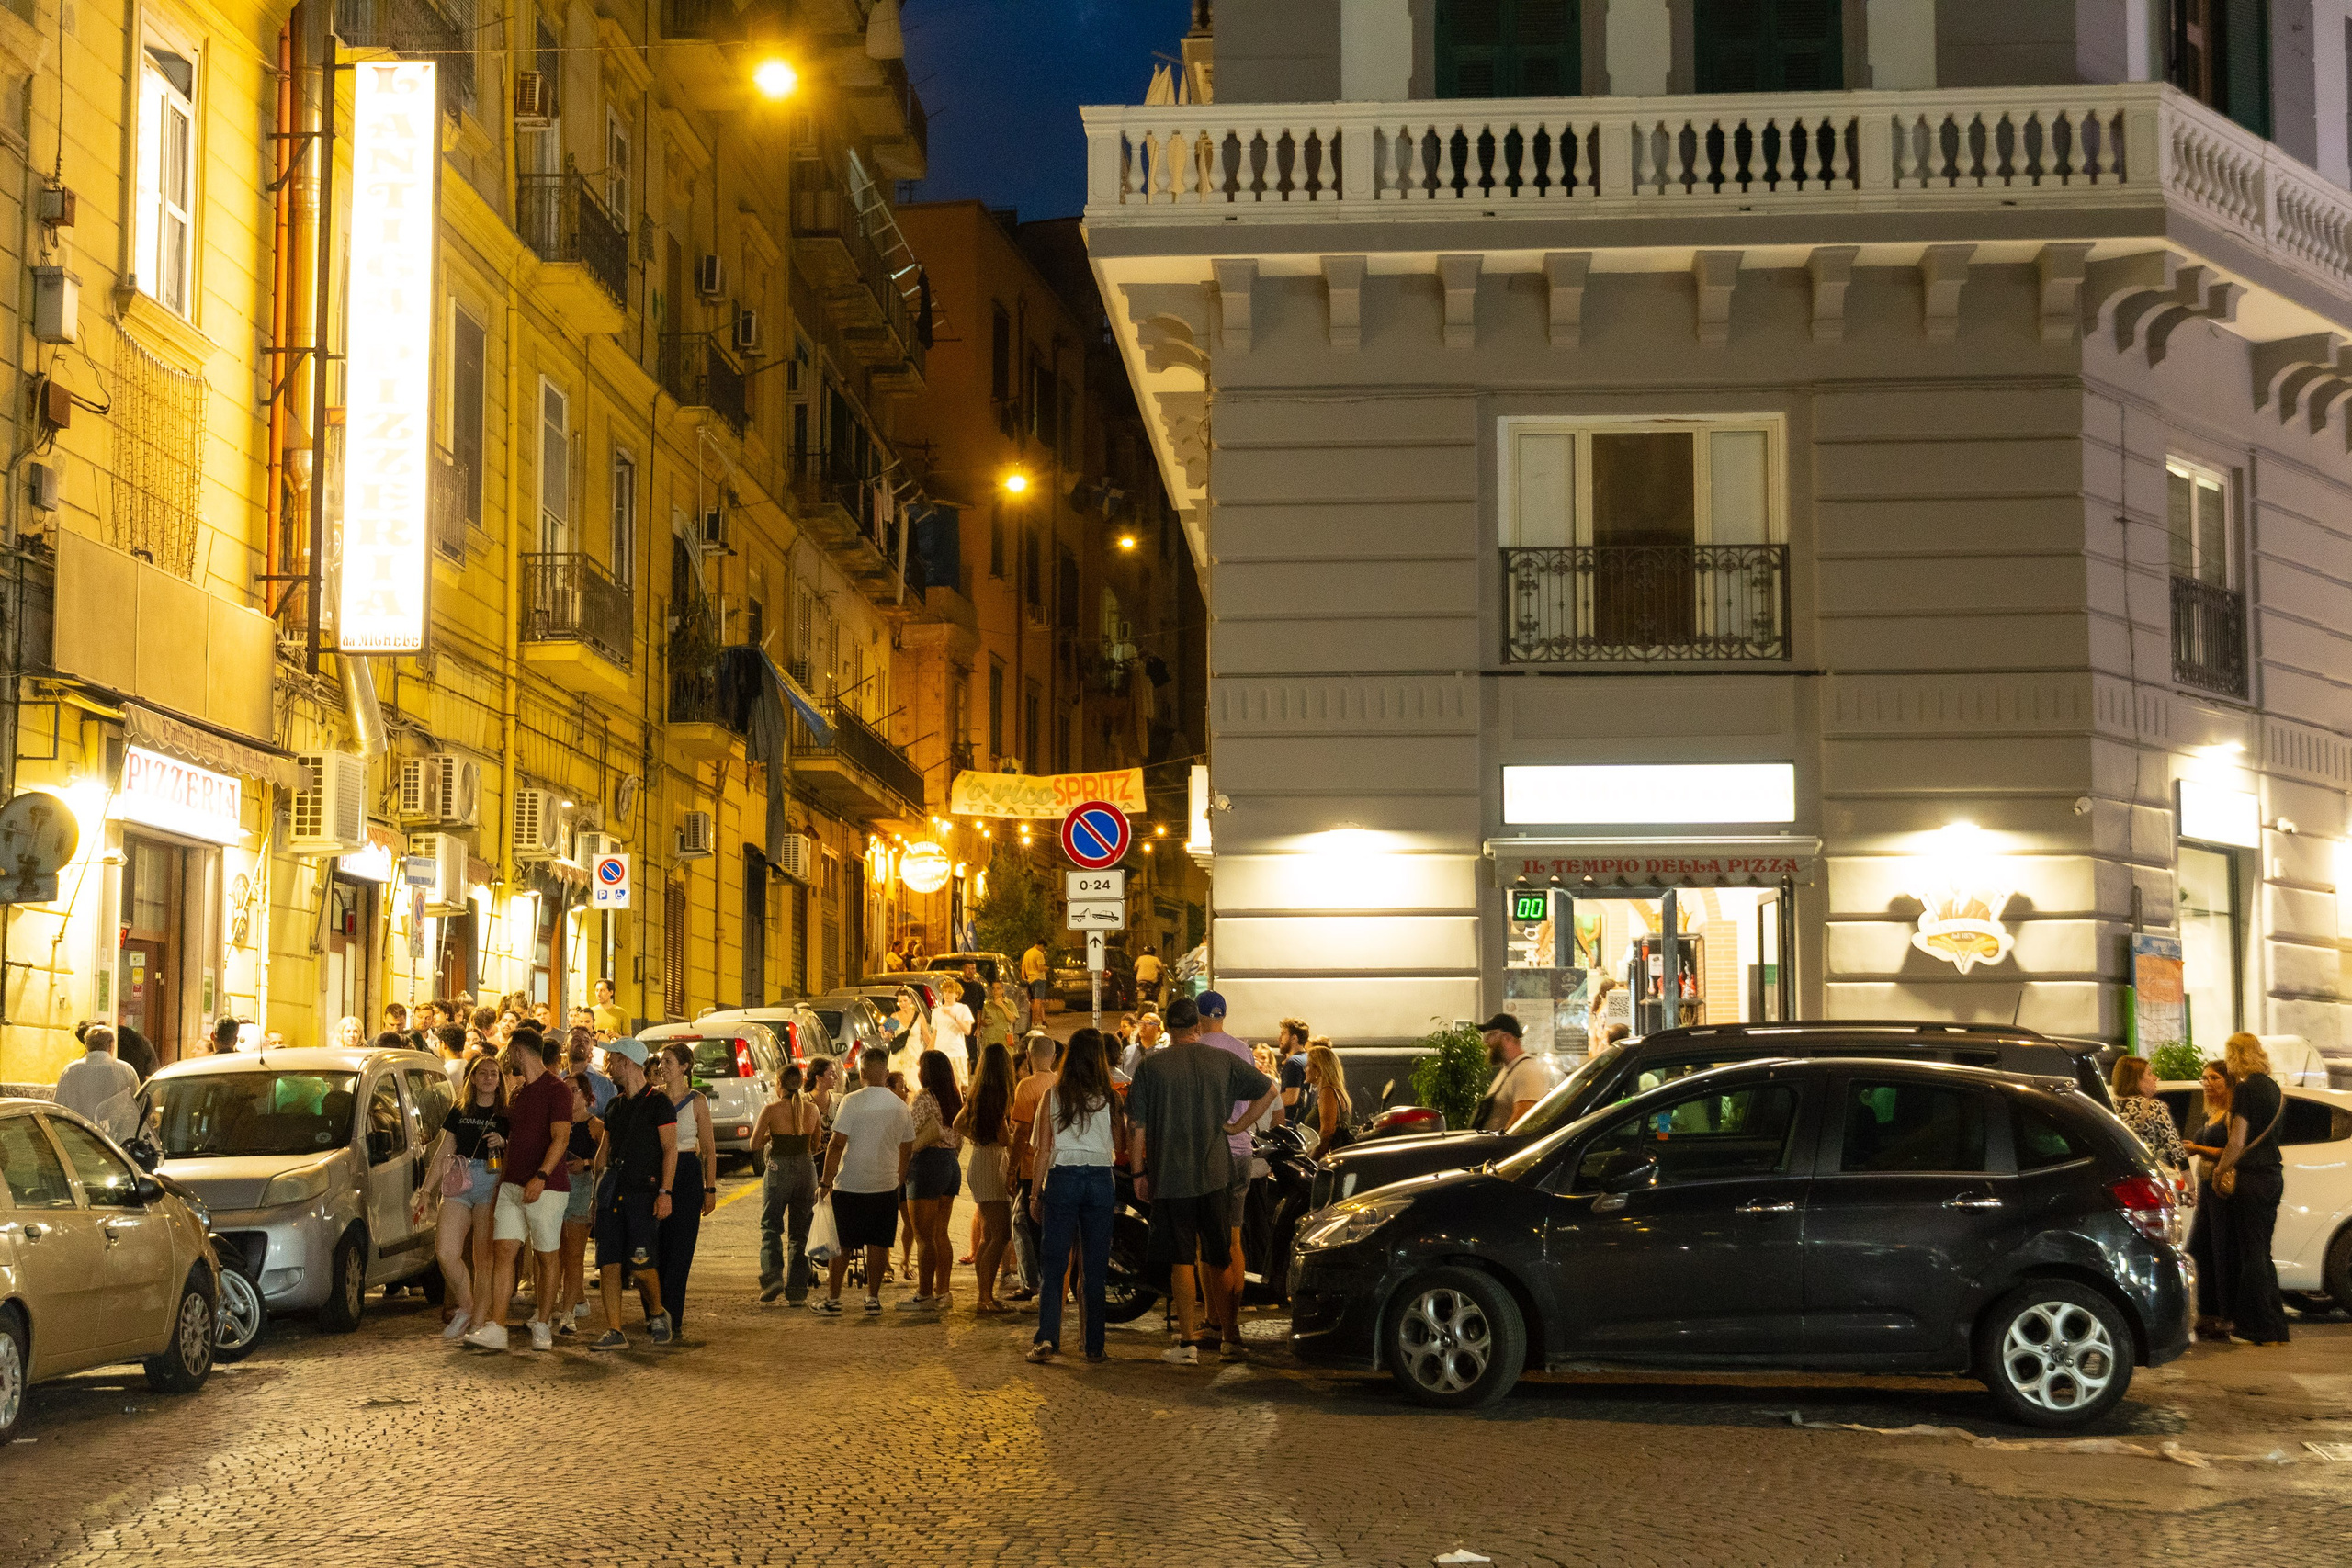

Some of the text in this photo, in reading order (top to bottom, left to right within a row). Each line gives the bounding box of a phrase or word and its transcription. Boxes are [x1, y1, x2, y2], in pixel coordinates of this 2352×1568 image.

[127, 752, 238, 819] PIZZERIA
[992, 777, 1059, 806] vico
[1053, 772, 1135, 807] SPRITZ
[964, 801, 1136, 817] TRATTA
[1522, 858, 1799, 874] IL TEMPIO DELLA PIZZA
[1079, 879, 1112, 891] 0-24
[1516, 897, 1544, 919] 00
